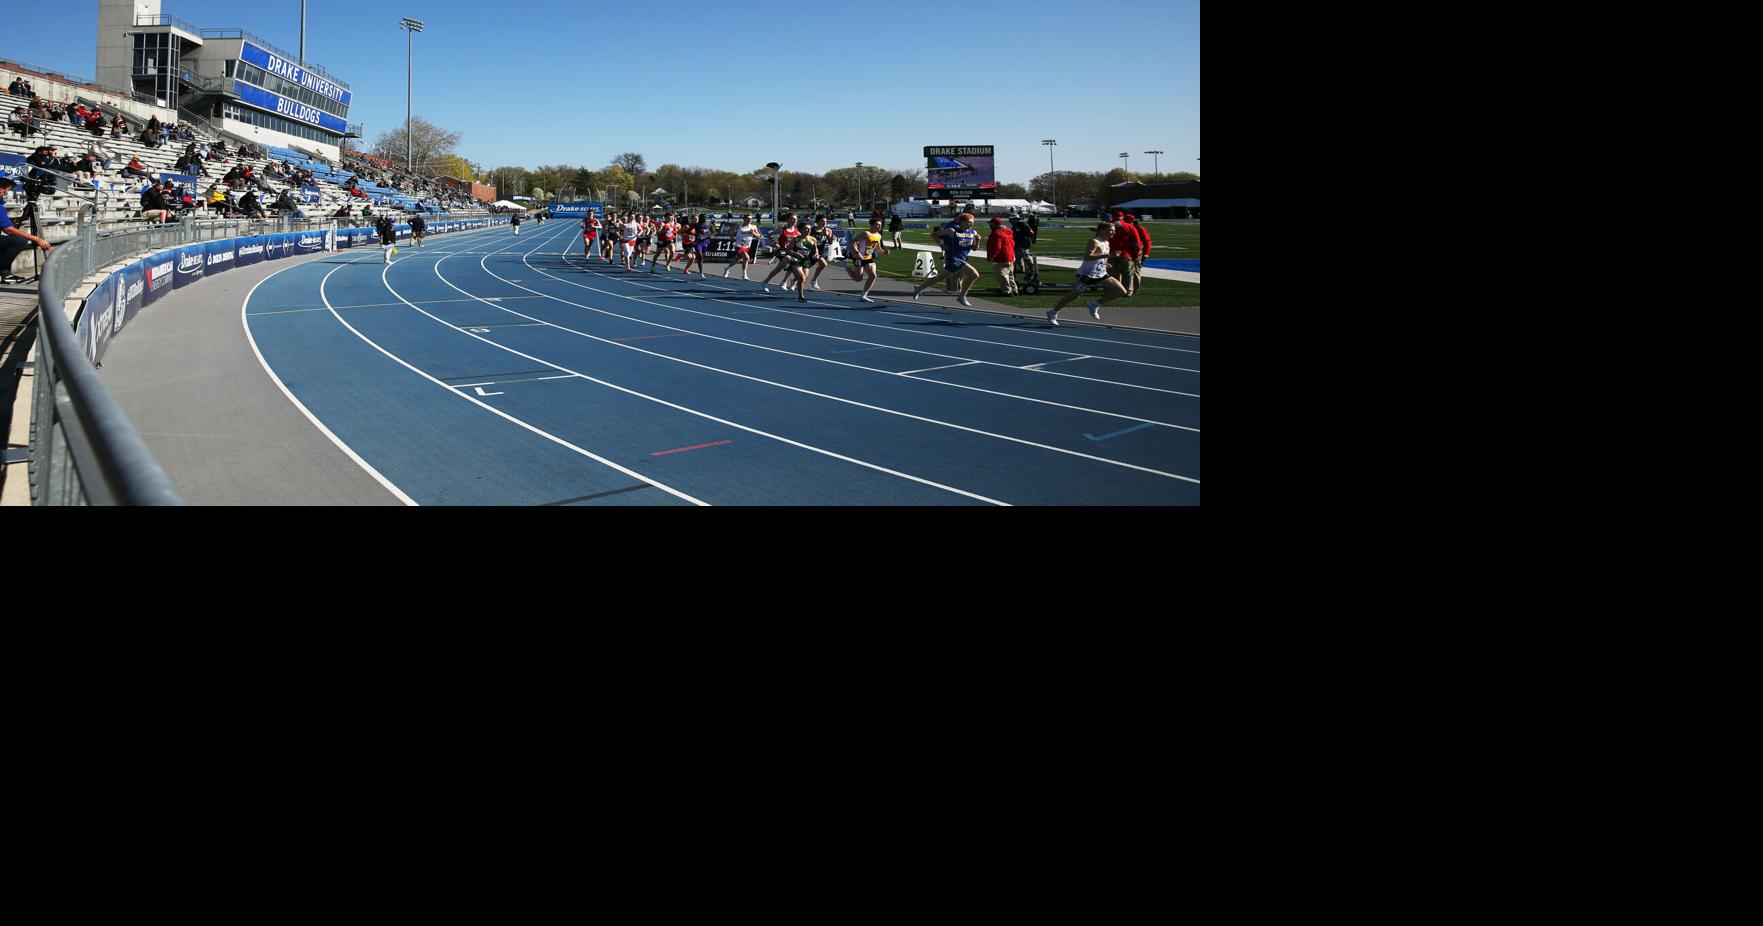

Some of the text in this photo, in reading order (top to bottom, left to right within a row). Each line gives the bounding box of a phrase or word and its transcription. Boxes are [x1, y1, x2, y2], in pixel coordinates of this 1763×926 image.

[268, 56, 344, 102] DRAKE UNIVERSITY
[277, 98, 321, 124] BULLDOGS
[930, 147, 992, 155] DRAKE STADIUM
[556, 204, 580, 212] Drake
[833, 246, 839, 256] 1
[916, 258, 923, 270] 2
